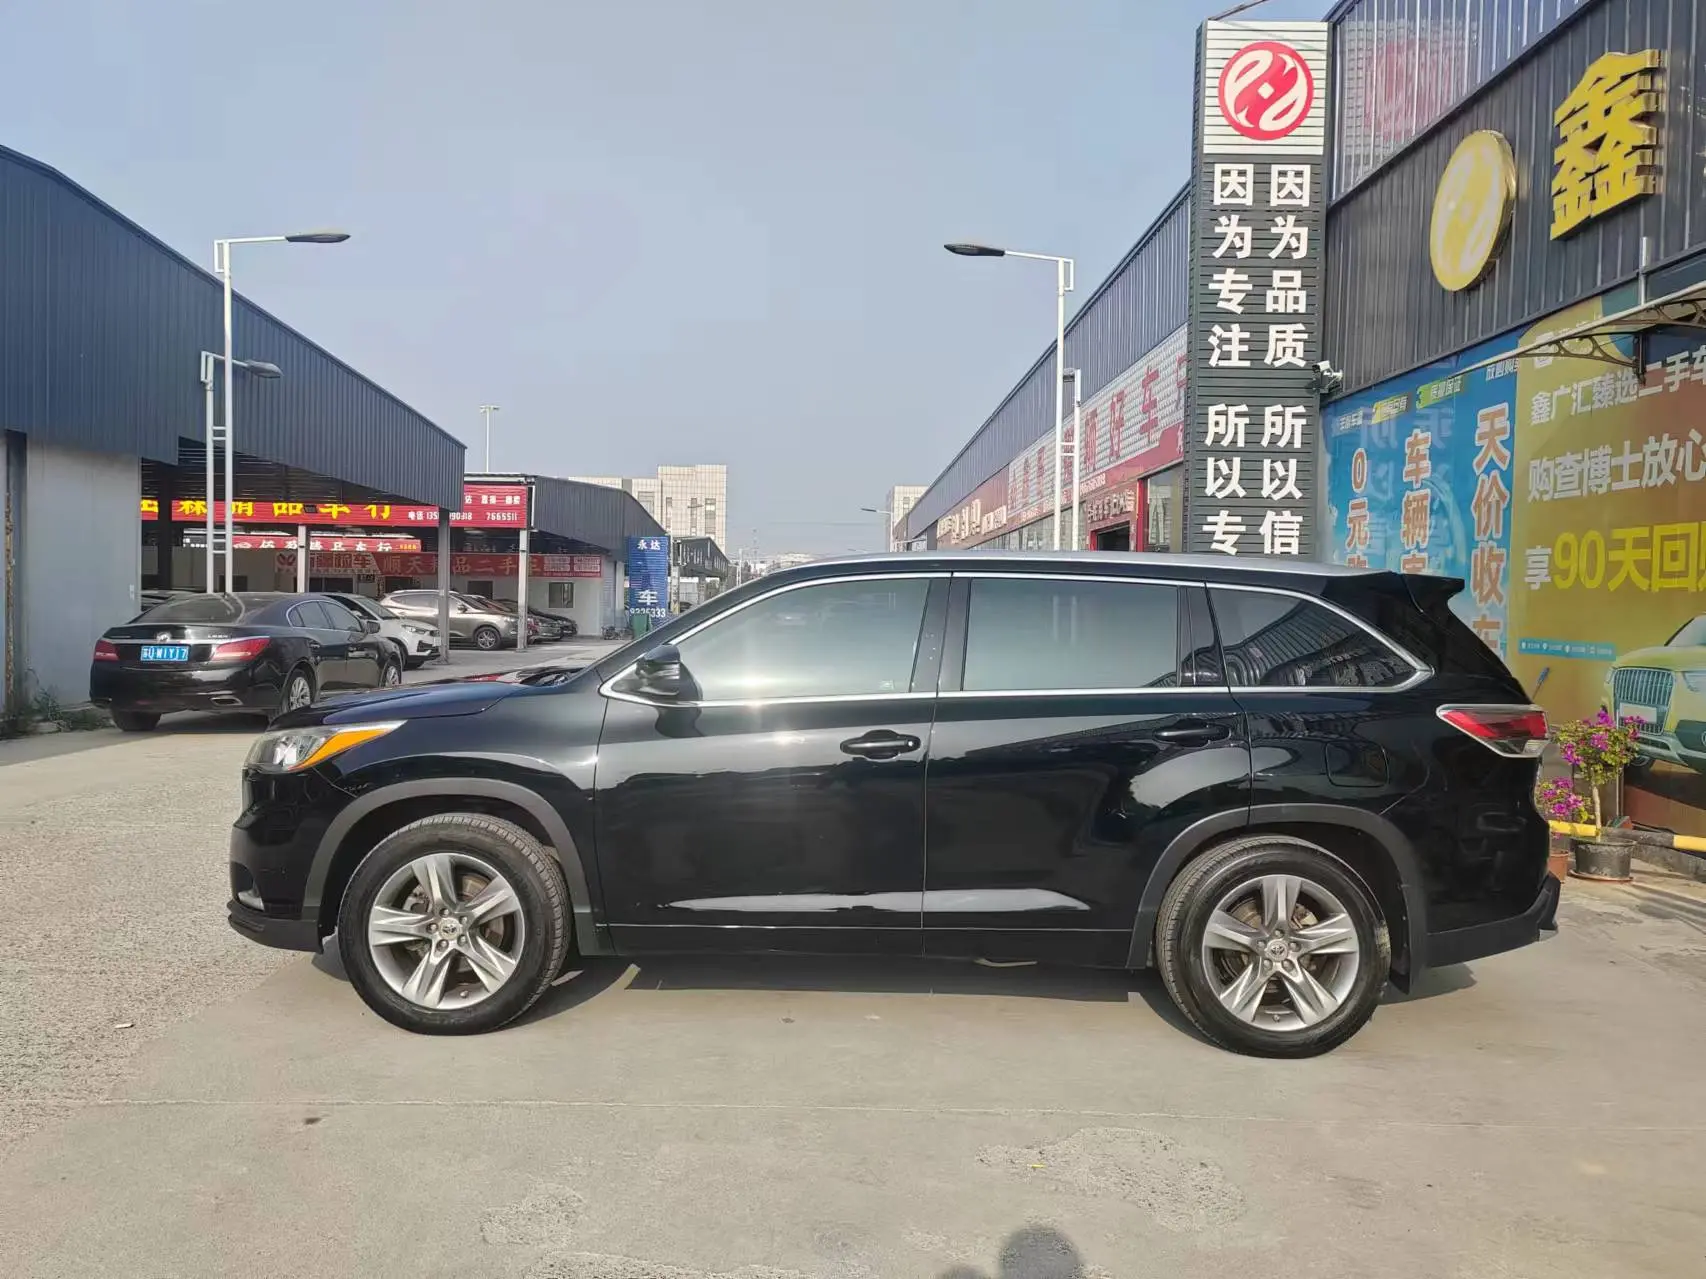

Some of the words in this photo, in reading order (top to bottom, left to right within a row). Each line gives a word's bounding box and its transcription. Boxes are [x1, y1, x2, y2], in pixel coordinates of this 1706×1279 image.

[1550, 49, 1659, 240] 鑫
[1208, 163, 1254, 368] 因为专注
[1264, 164, 1311, 368] 因为品质
[1202, 404, 1251, 556] 所以专
[1259, 404, 1307, 555] 所以信
[1524, 520, 1706, 594] 享90天回
